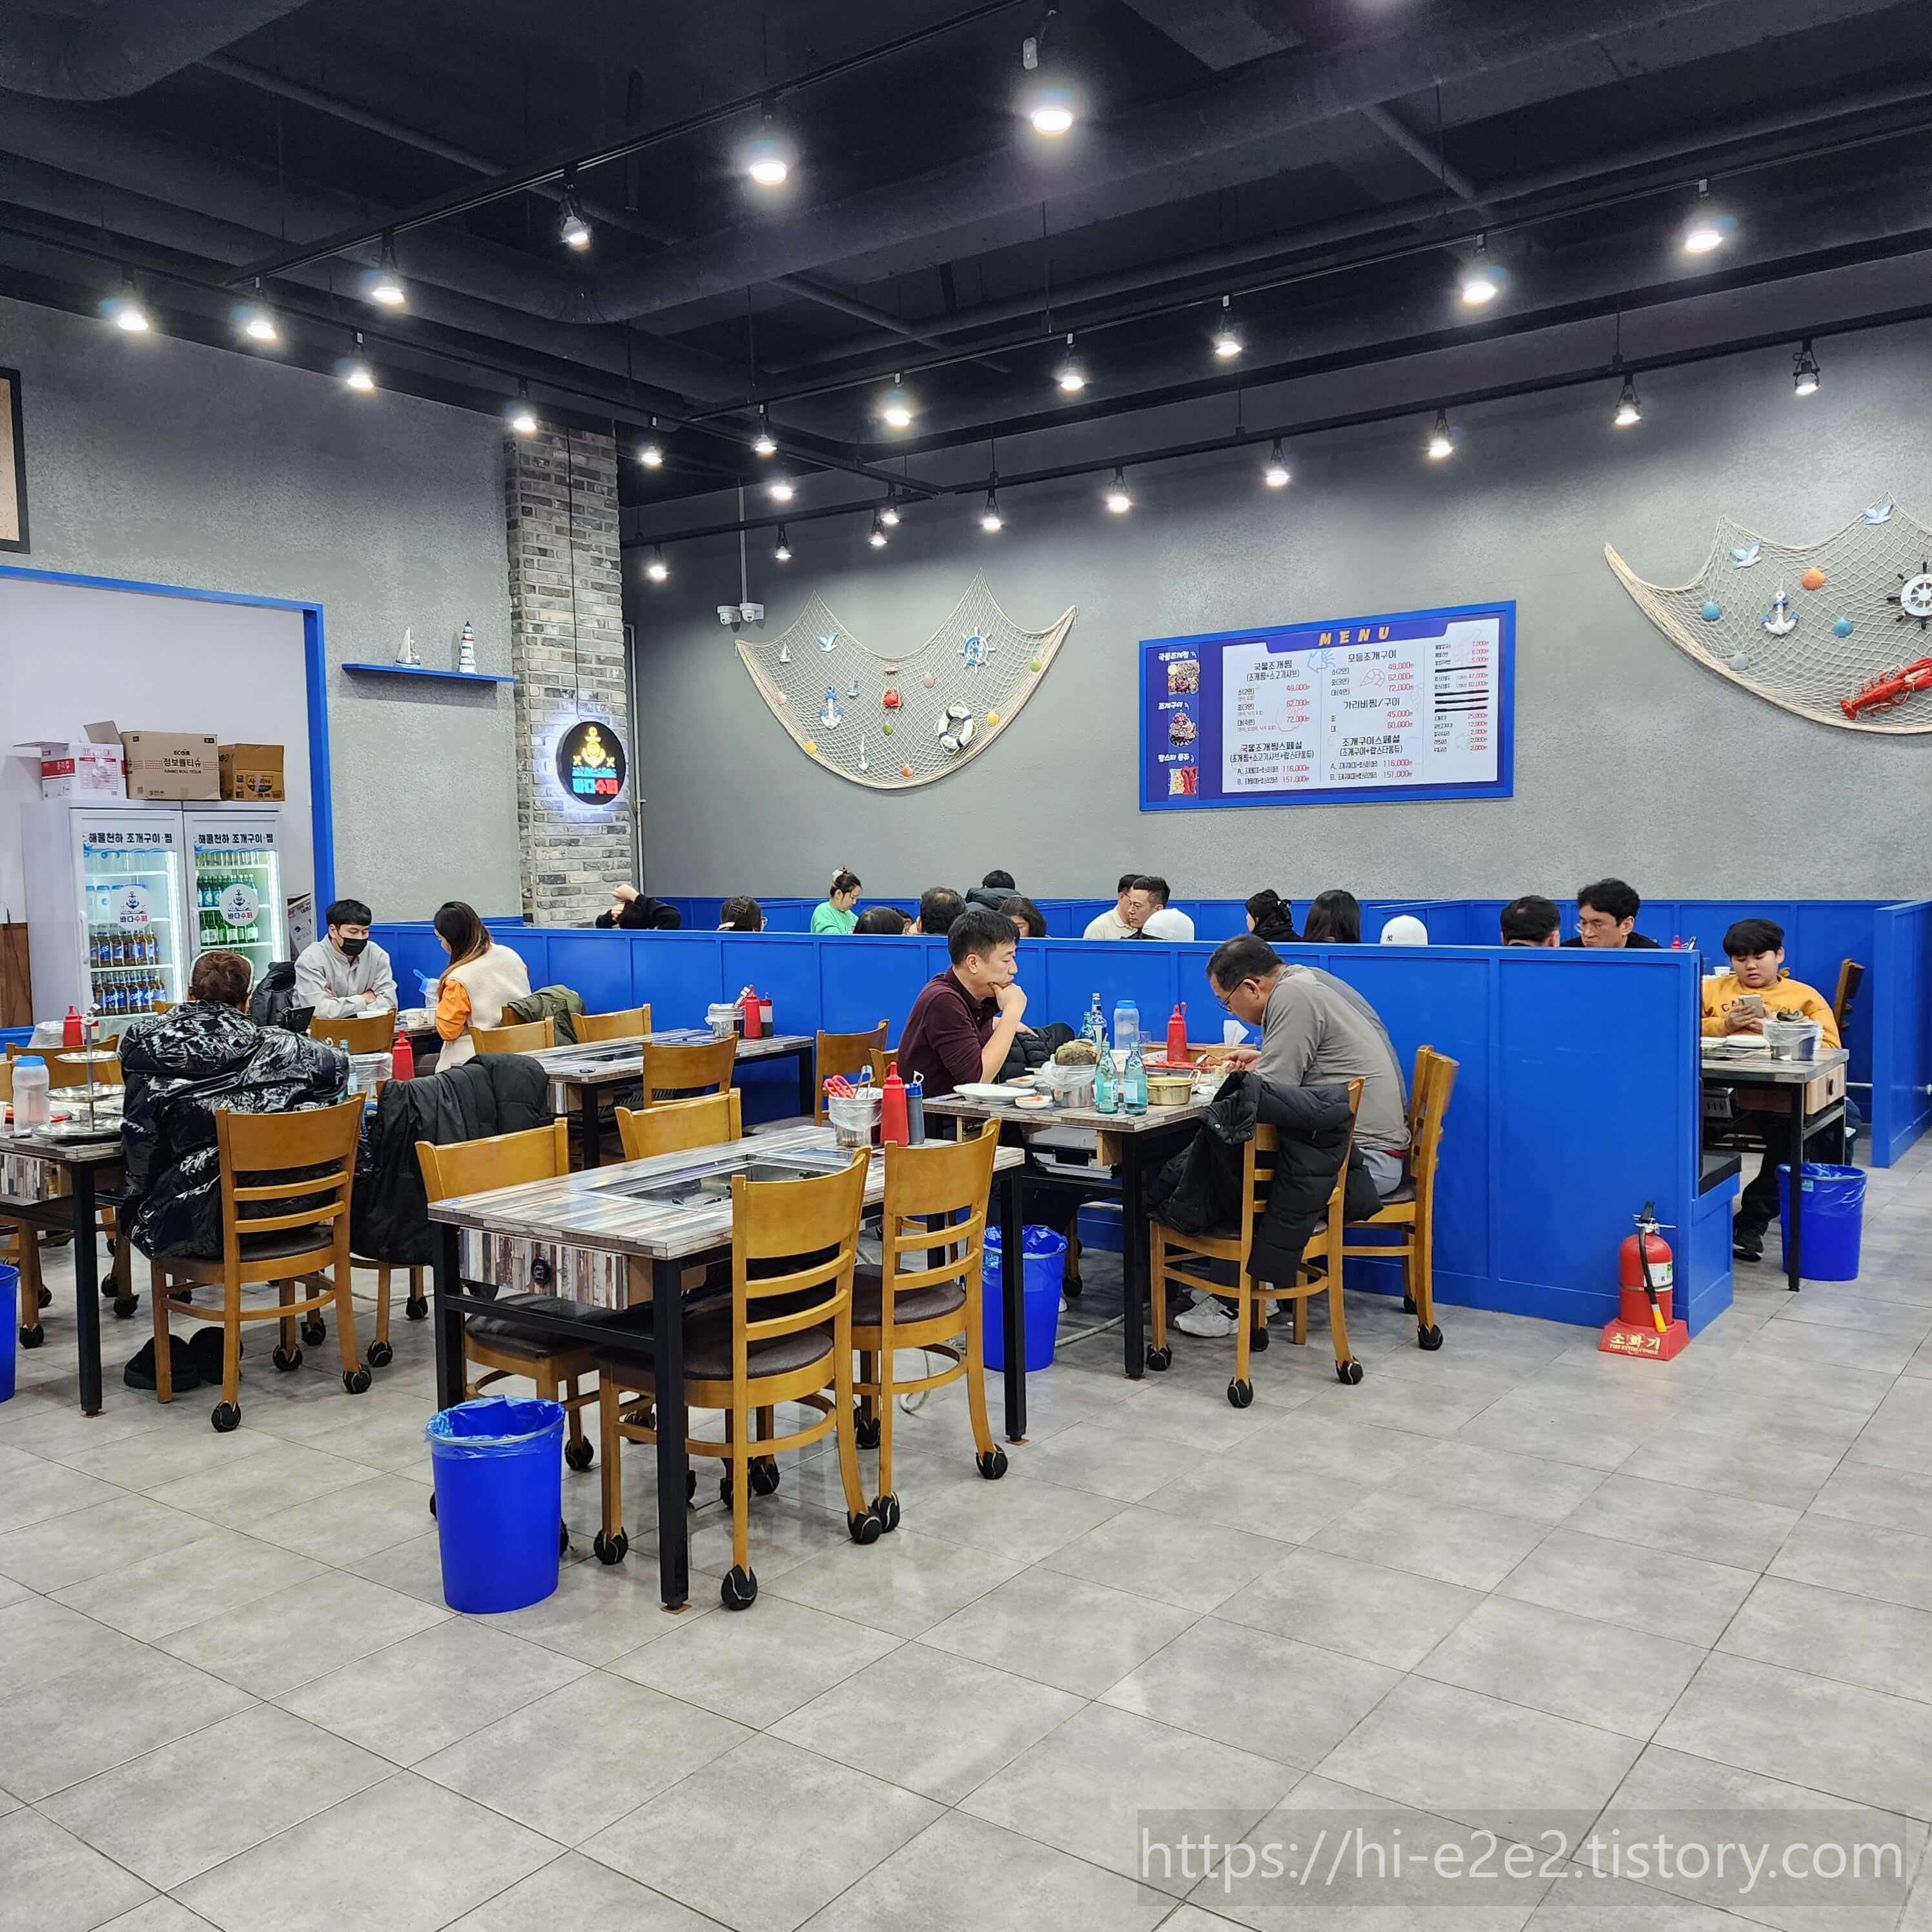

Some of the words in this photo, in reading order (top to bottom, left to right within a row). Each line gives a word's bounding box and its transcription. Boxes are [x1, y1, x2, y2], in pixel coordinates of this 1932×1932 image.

[1319, 626, 1390, 646] MENU
[1348, 650, 1397, 662] 모듬조개구이
[1254, 659, 1292, 670] 국물조개찜
[1343, 697, 1400, 710] 가리비찜/구이
[88, 832, 123, 843] 해물천하
[198, 834, 229, 844] 해물천하
[228, 911, 254, 920] 바다수퍼
[1610, 1332, 1661, 1351] 소화기
